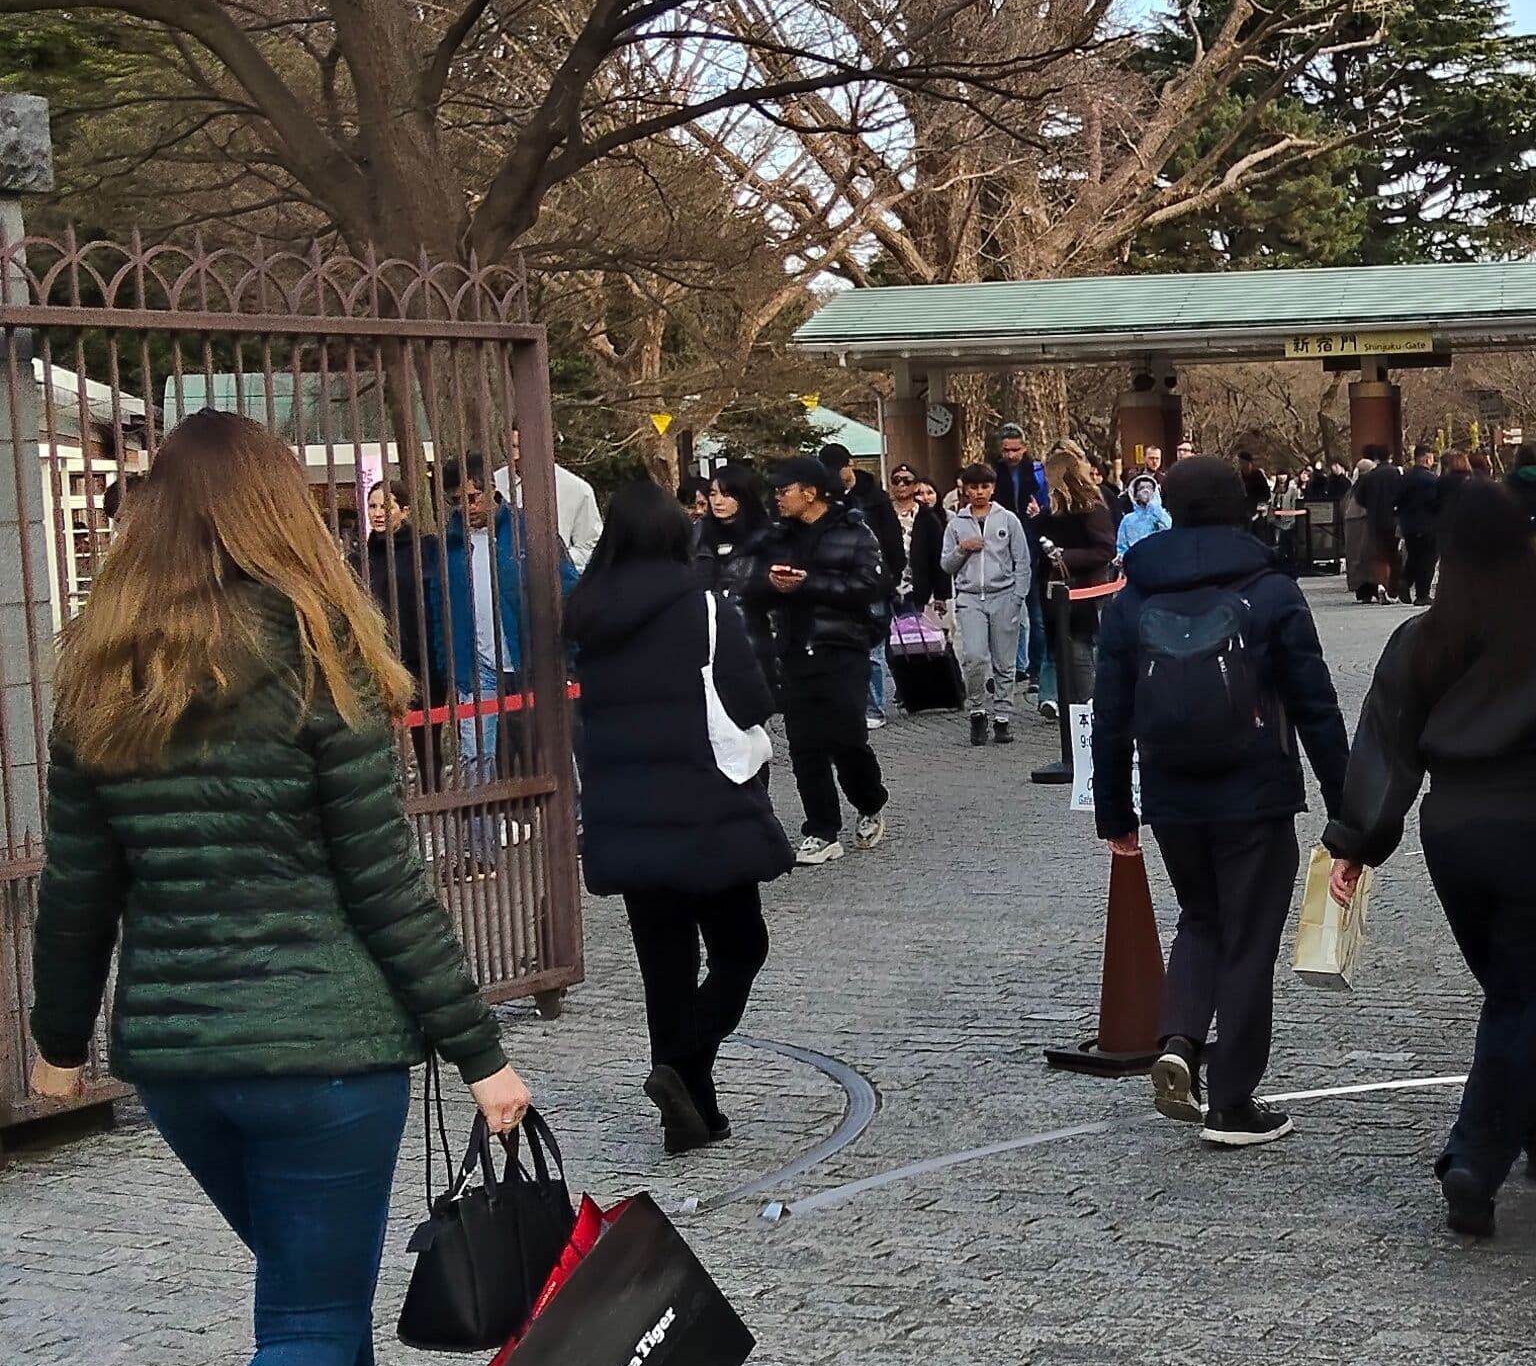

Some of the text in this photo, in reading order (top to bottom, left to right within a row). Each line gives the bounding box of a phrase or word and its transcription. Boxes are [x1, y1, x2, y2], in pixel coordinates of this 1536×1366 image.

[1293, 336, 1357, 353] 新宿門
[635, 1306, 676, 1358] Tiger
